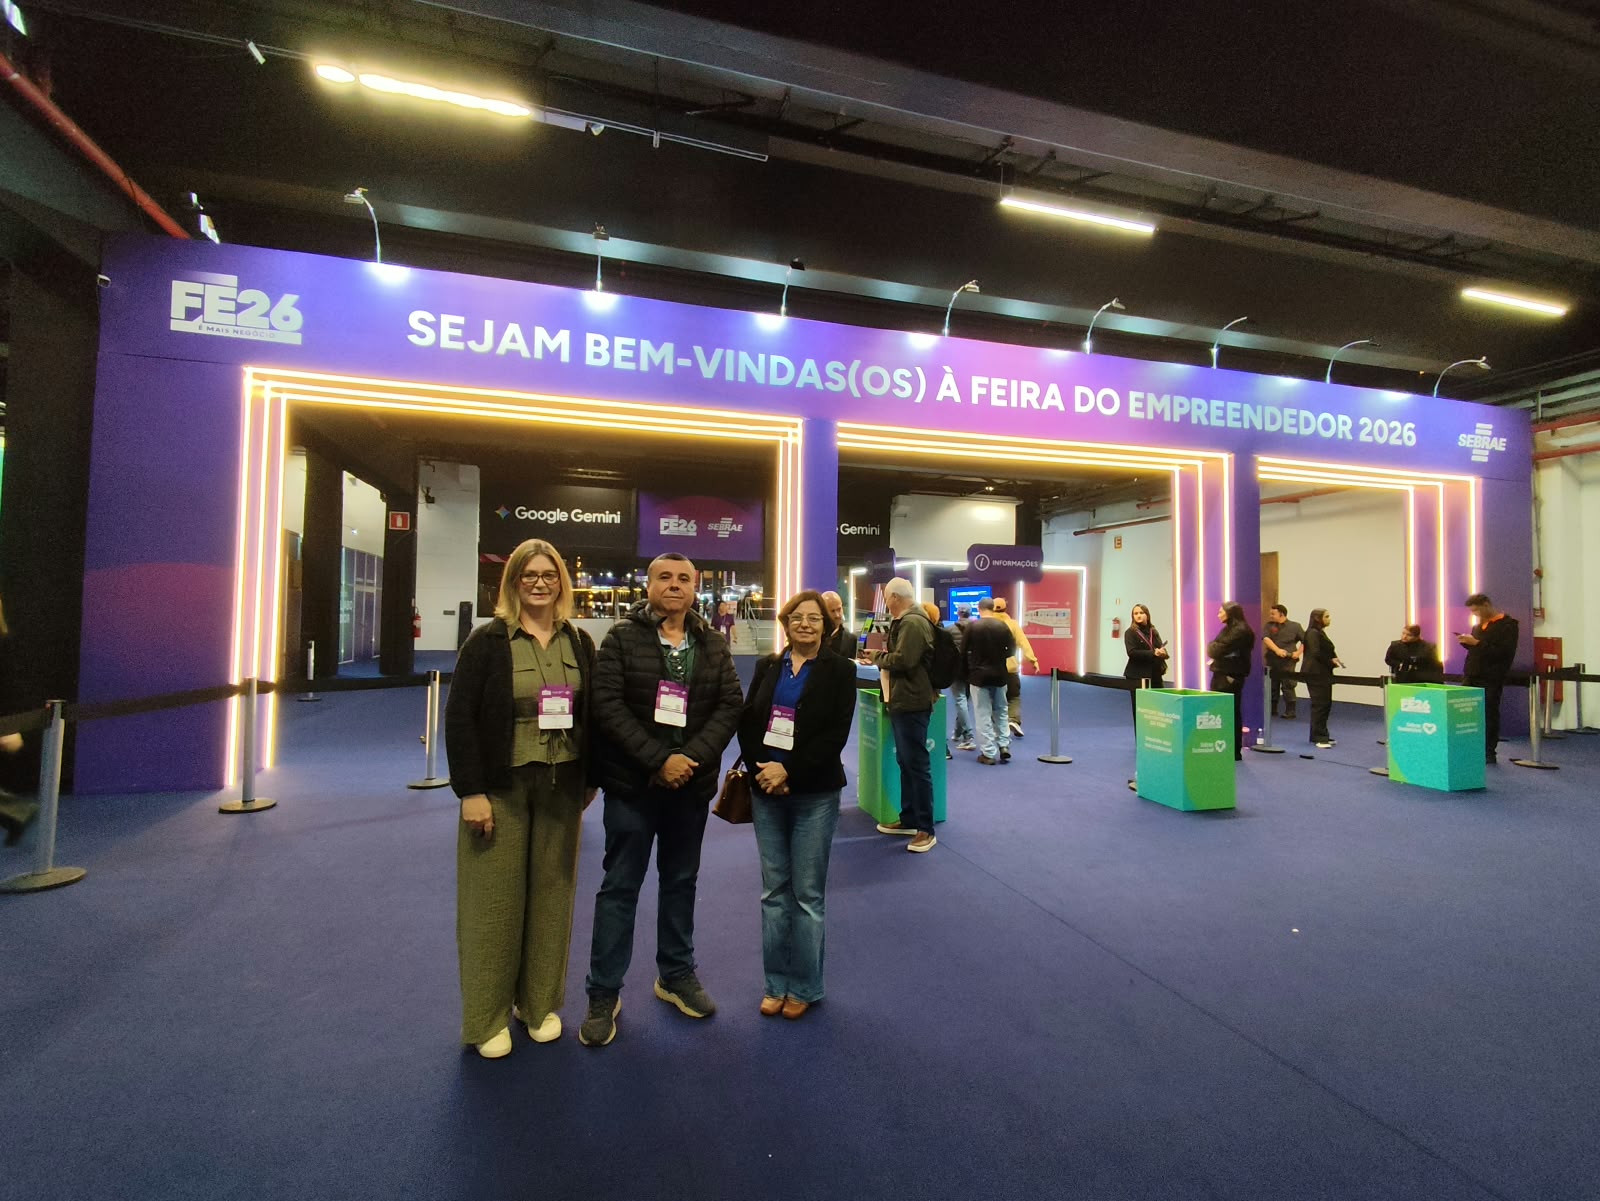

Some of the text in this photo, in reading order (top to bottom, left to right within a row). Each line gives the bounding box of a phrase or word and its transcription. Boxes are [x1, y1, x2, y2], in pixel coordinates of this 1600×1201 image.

[171, 280, 303, 332] FE26
[206, 326, 230, 334] MAIS
[232, 329, 275, 339] NEGÓCIO
[407, 310, 1417, 446] SEJAM BEM-VINDAS(OS) À FEIRA DO EMPREENDEDOR 2026
[1457, 433, 1507, 452] SEBRAE
[514, 506, 621, 524] Google Gemini
[660, 518, 697, 532] FE26
[707, 523, 744, 532] SEBRAE
[840, 523, 880, 536] Gemini
[992, 559, 1039, 568] INFORMAÇÕES
